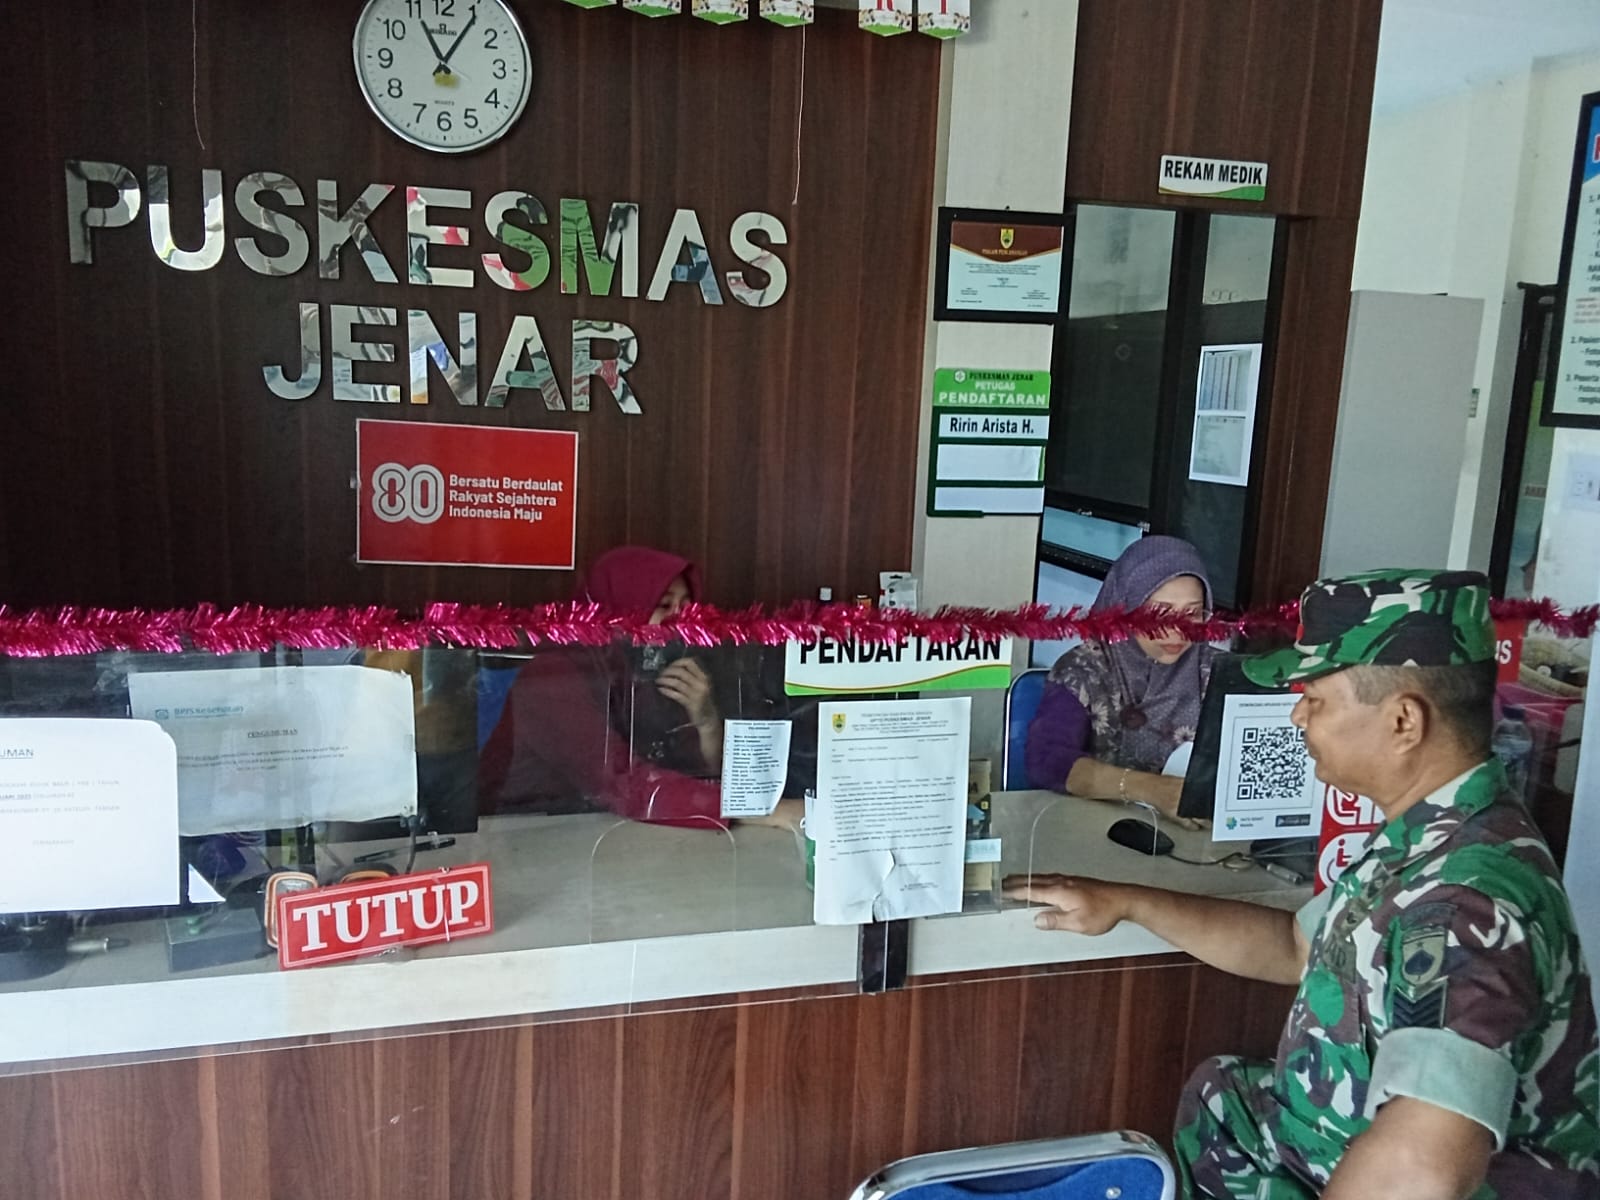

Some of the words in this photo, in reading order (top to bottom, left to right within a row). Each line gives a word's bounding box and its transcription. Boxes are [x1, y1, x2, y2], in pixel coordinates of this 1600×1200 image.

[405, 0, 422, 19] 11
[433, 0, 455, 17] 12
[384, 19, 405, 40] 10
[484, 28, 498, 50] 2
[378, 47, 393, 69] 9
[493, 58, 506, 79] 3
[388, 78, 402, 99] 8
[484, 88, 500, 108] 4
[413, 103, 426, 123] 7
[437, 111, 452, 131] 6
[464, 108, 478, 129] 5
[1164, 159, 1215, 182] REKAM
[1218, 164, 1264, 185] MEDIK
[65, 159, 789, 308] PUSKESMAS
[262, 302, 644, 415] JENAR
[974, 381, 1016, 391] PETUGAS
[938, 391, 1047, 406] PENDAFTARAN
[949, 416, 978, 433] Ririn
[981, 417, 1018, 434] Arista
[1021, 419, 1035, 434] H.
[372, 462, 445, 525] 80
[449, 474, 500, 489] Bersatu
[502, 477, 564, 492] Berdaulat
[449, 490, 493, 506] Rakyat
[496, 492, 558, 508] Sejahtera
[449, 505, 512, 520] Indonesia
[513, 508, 543, 524] Maju
[800, 633, 1001, 665] PENDAFTARAN
[293, 879, 479, 952] TUTUP
